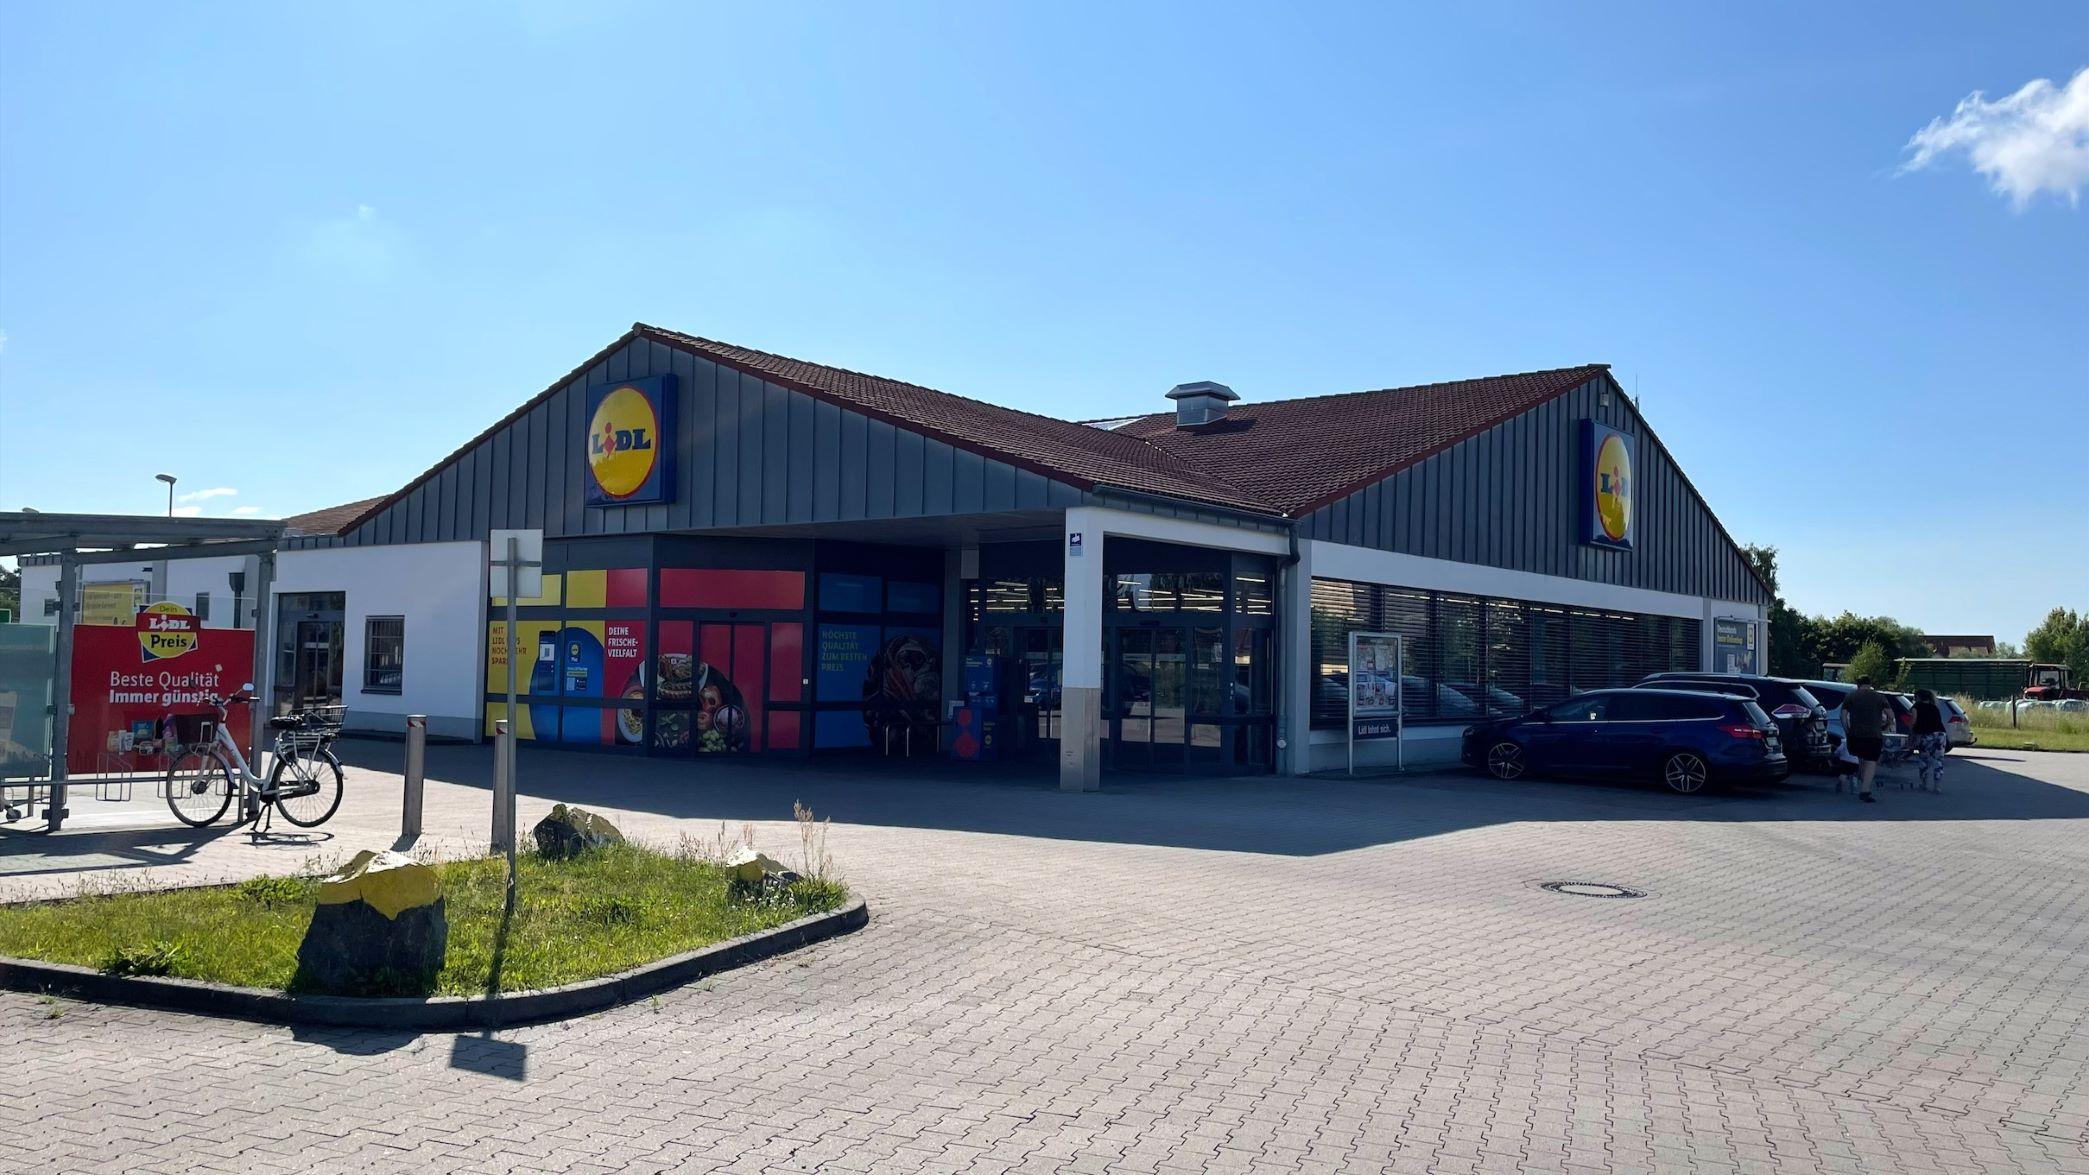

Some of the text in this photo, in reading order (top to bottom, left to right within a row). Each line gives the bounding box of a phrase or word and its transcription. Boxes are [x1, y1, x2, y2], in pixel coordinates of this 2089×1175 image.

[492, 626, 504, 635] MIT
[608, 626, 629, 636] DEINE
[150, 634, 188, 649] Preis
[608, 637, 639, 647] FRISCHE-
[608, 648, 638, 658] VIELFALT
[110, 671, 154, 687] Beste
[109, 689, 159, 704] Immer
